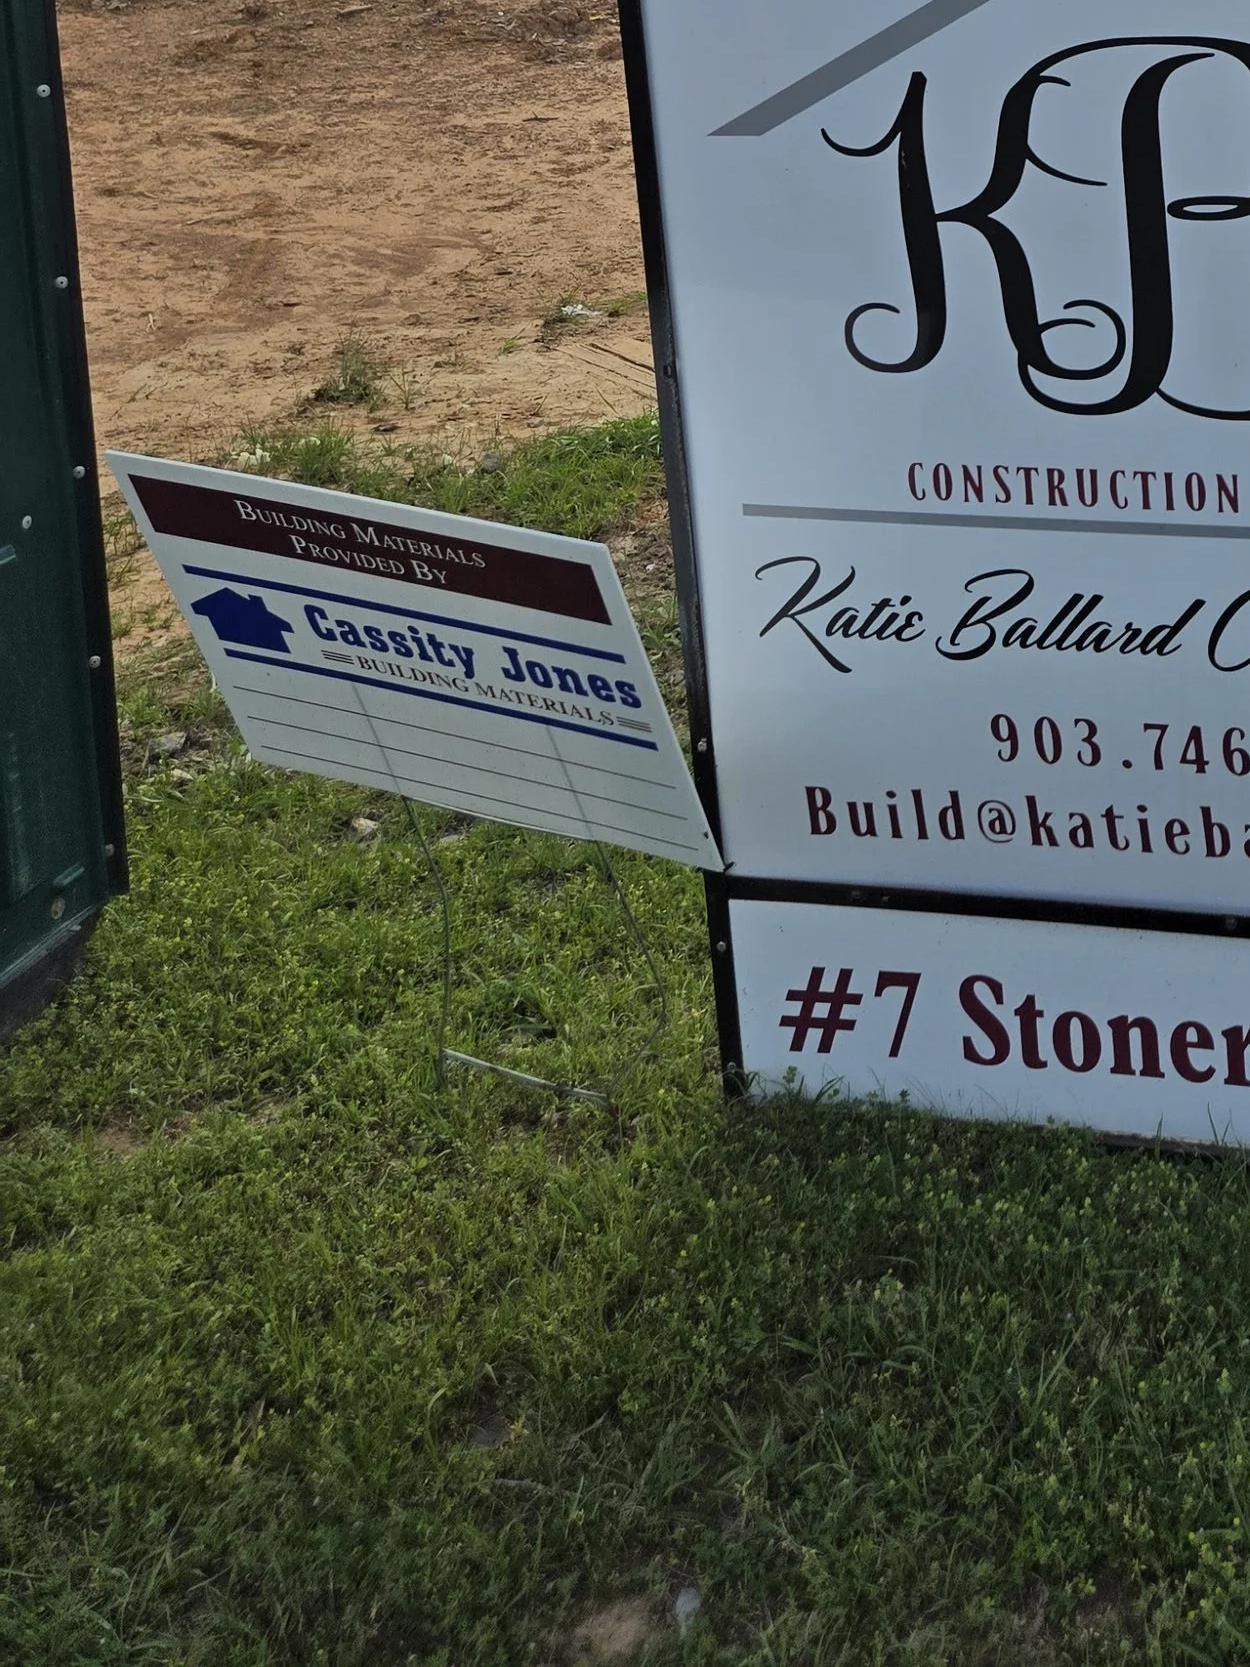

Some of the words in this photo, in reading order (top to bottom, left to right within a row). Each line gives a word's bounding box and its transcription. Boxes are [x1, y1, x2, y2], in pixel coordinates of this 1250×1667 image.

[907, 462, 1239, 513] CONSTRUCTION
[303, 604, 474, 679] Cassity
[501, 645, 642, 709] Jones
[754, 555, 927, 674] Katie
[934, 568, 1208, 662] Ballard
[356, 654, 469, 693] BUILDING
[475, 681, 615, 726] MATERIALS
[778, 965, 922, 1059] #7
